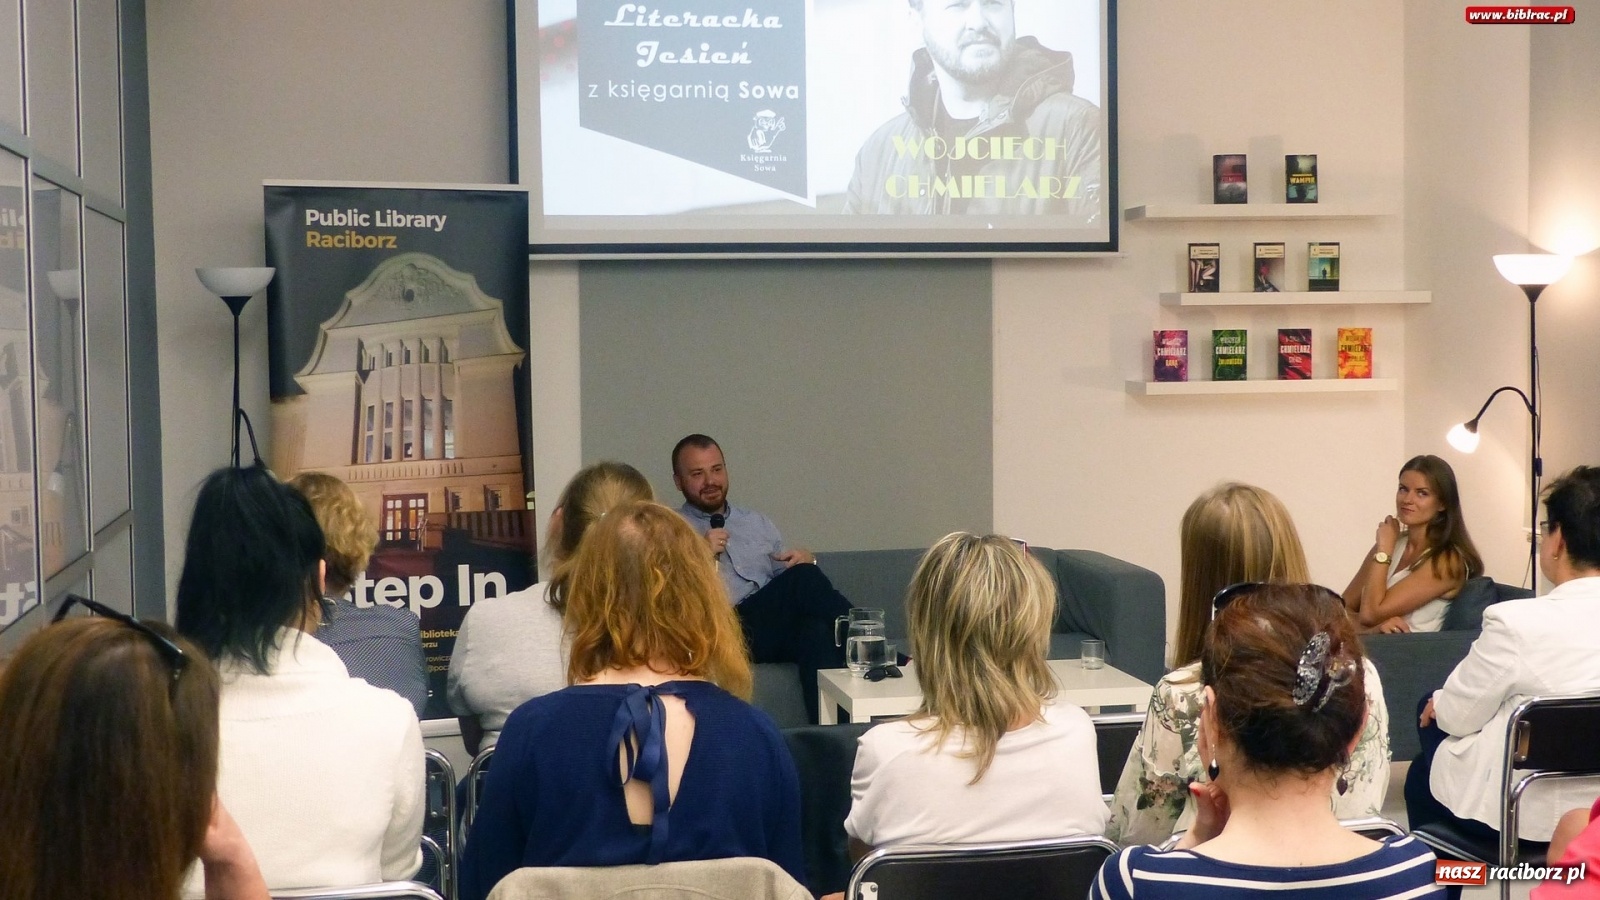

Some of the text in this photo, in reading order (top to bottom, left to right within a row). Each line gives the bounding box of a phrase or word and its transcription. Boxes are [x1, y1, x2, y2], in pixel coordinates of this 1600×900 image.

[604, 3, 783, 29] Literacka
[635, 40, 753, 67] Jesień
[588, 78, 800, 104] z księgarnią Sowa
[740, 153, 787, 165] Księgarnia
[892, 136, 1068, 161] WOJCIECH
[753, 163, 777, 172] Sowa
[884, 174, 1082, 200] CHMIELARZ
[305, 208, 447, 232] Public Library
[305, 230, 398, 250] Raciborz
[457, 564, 507, 607] In
